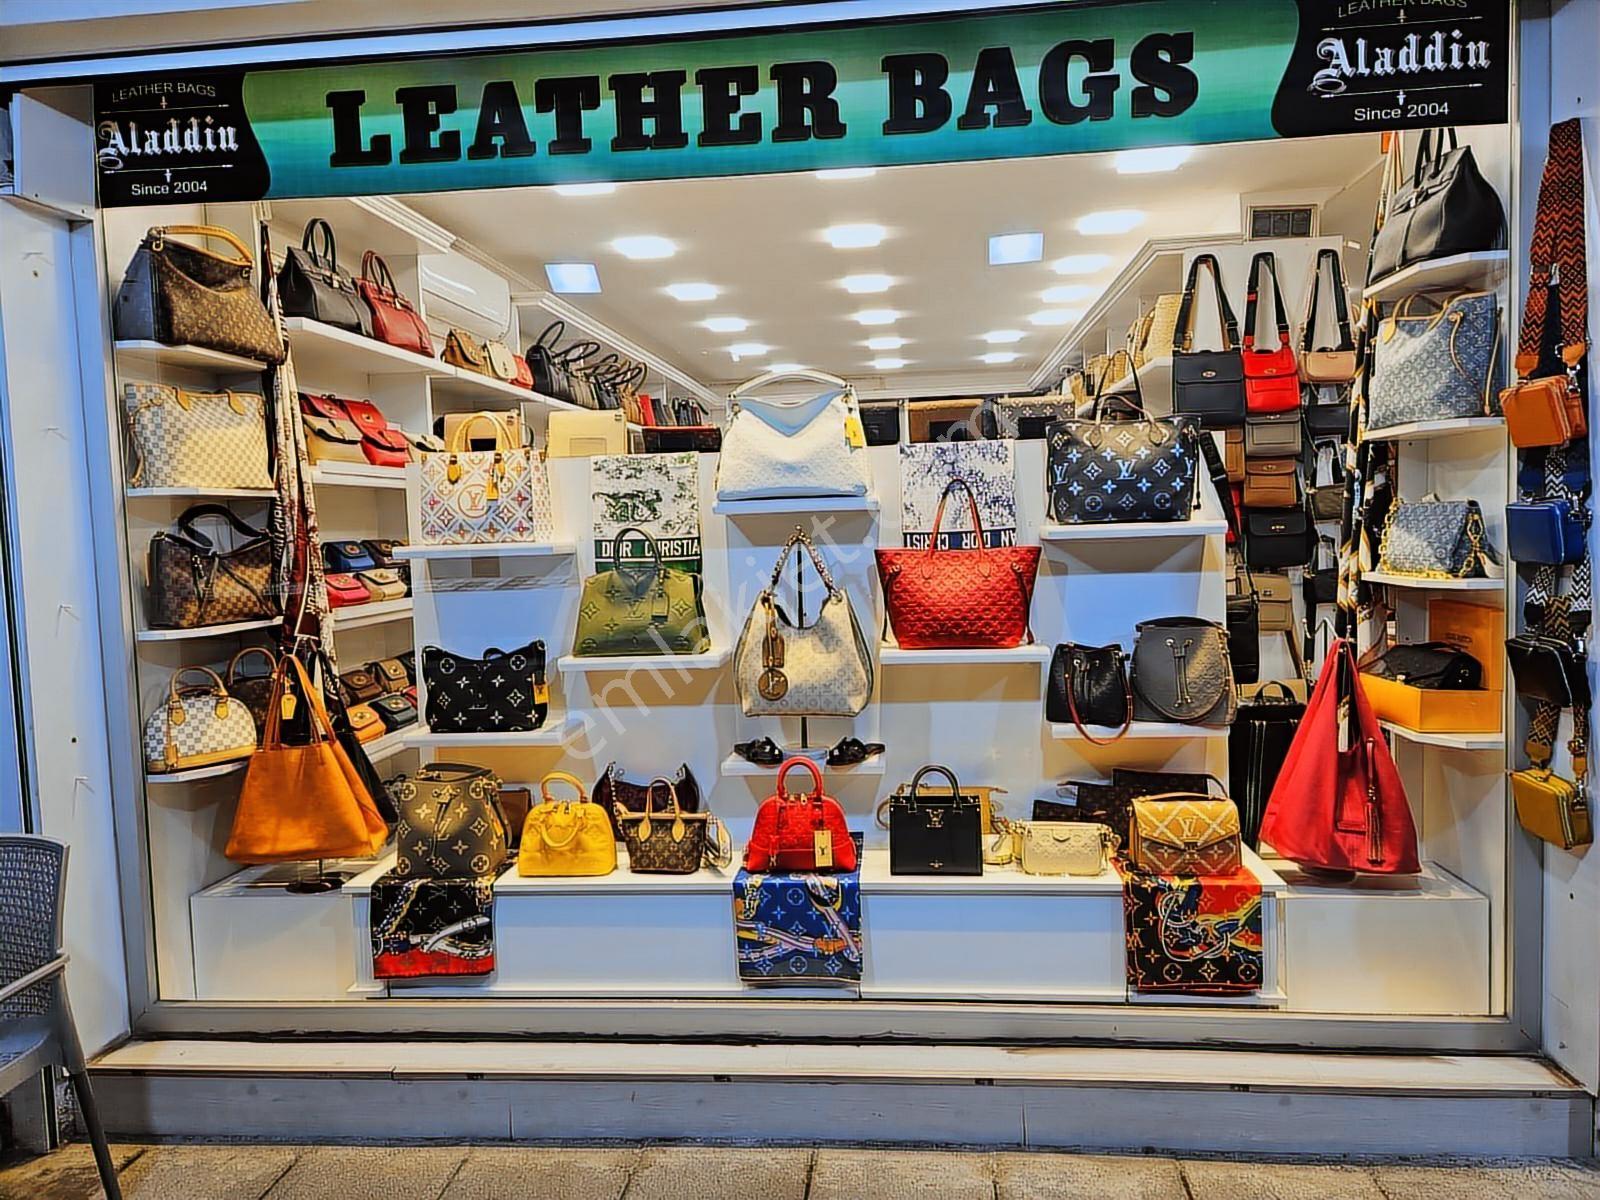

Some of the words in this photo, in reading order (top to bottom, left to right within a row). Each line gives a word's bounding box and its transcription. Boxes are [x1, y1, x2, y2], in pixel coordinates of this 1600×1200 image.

[1307, 29, 1491, 95] Aladdin
[112, 82, 174, 103] LEATHER
[177, 82, 216, 97] BAGS
[325, 60, 848, 169] LEATHER
[880, 31, 1199, 136] BAGS
[1353, 106, 1401, 122] Since
[1406, 102, 1450, 118] 2004
[98, 115, 240, 170] Aladdin
[131, 183, 170, 196] Since
[173, 180, 208, 194] 2004
[961, 532, 991, 550] DOR
